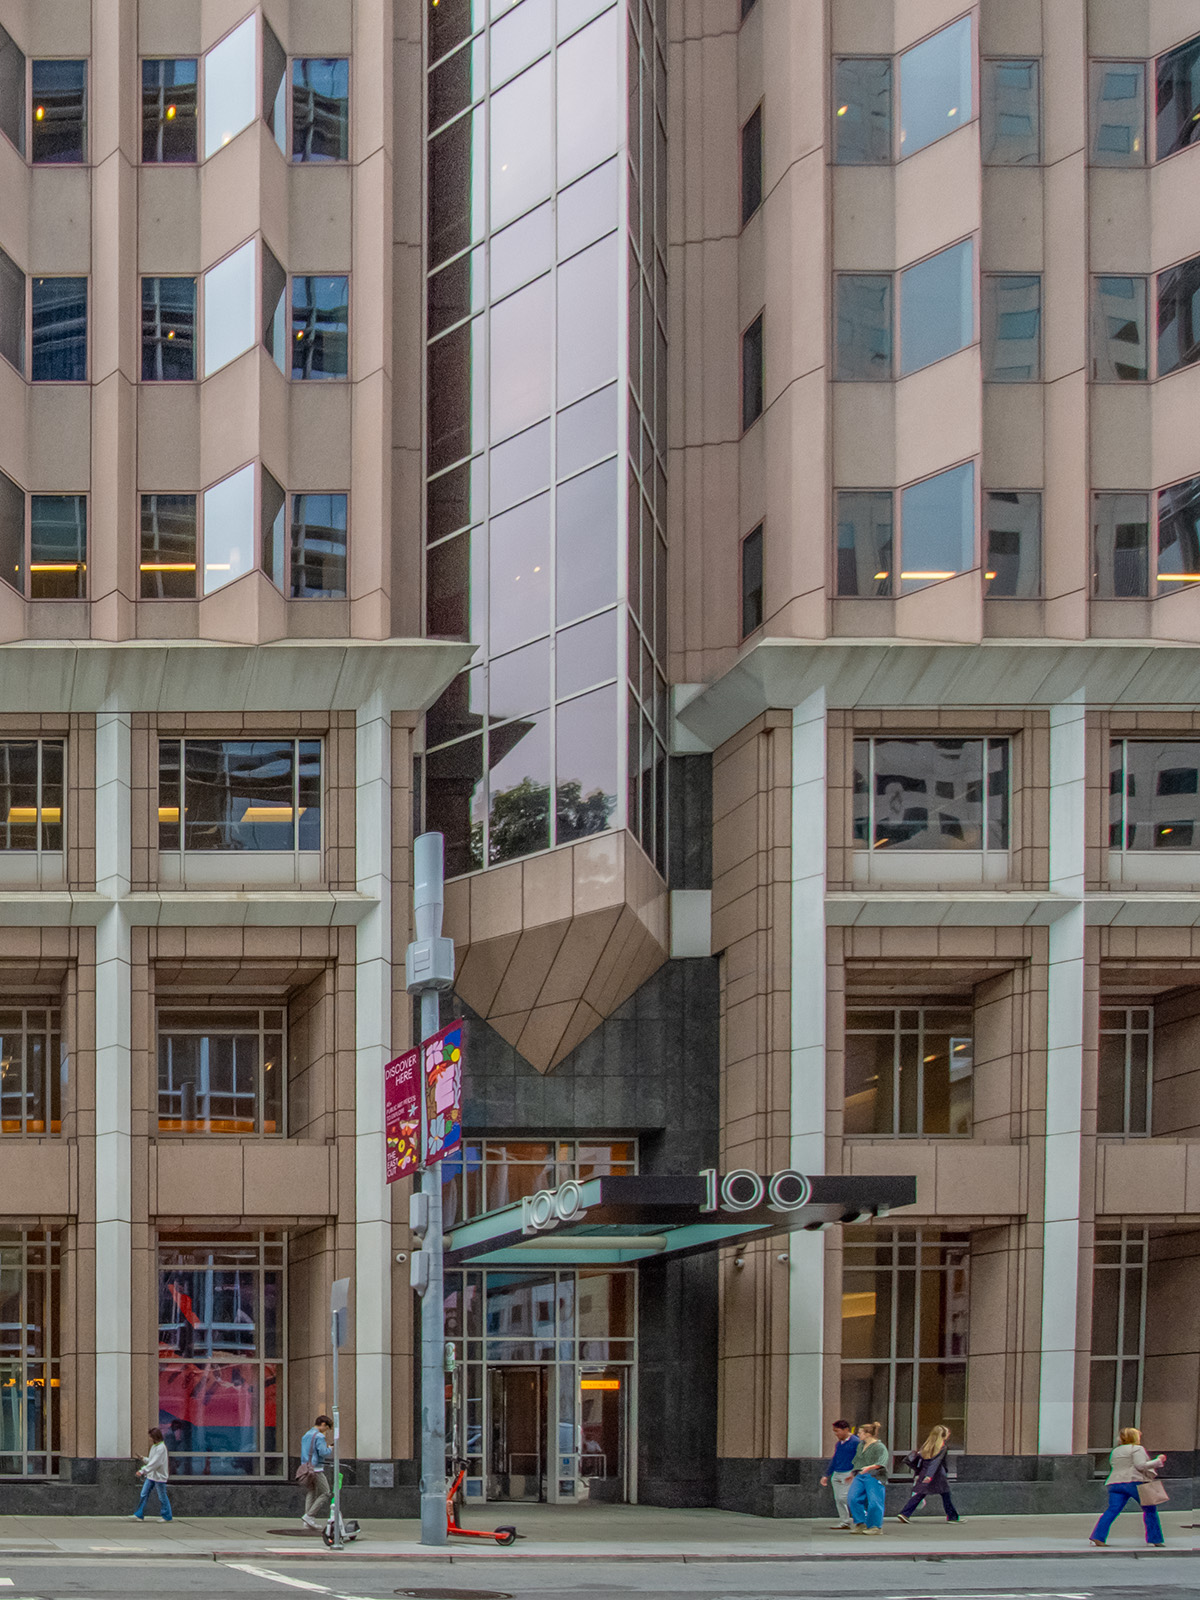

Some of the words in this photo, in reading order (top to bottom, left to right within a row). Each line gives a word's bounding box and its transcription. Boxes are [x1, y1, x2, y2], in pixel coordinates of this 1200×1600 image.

[385, 1054, 417, 1080] DISCOVER
[395, 1068, 413, 1086] HERE
[387, 1150, 397, 1159] THE
[387, 1157, 399, 1169] EAST
[387, 1166, 397, 1178] CUT
[700, 1168, 813, 1212] 100
[522, 1179, 584, 1235] 100
